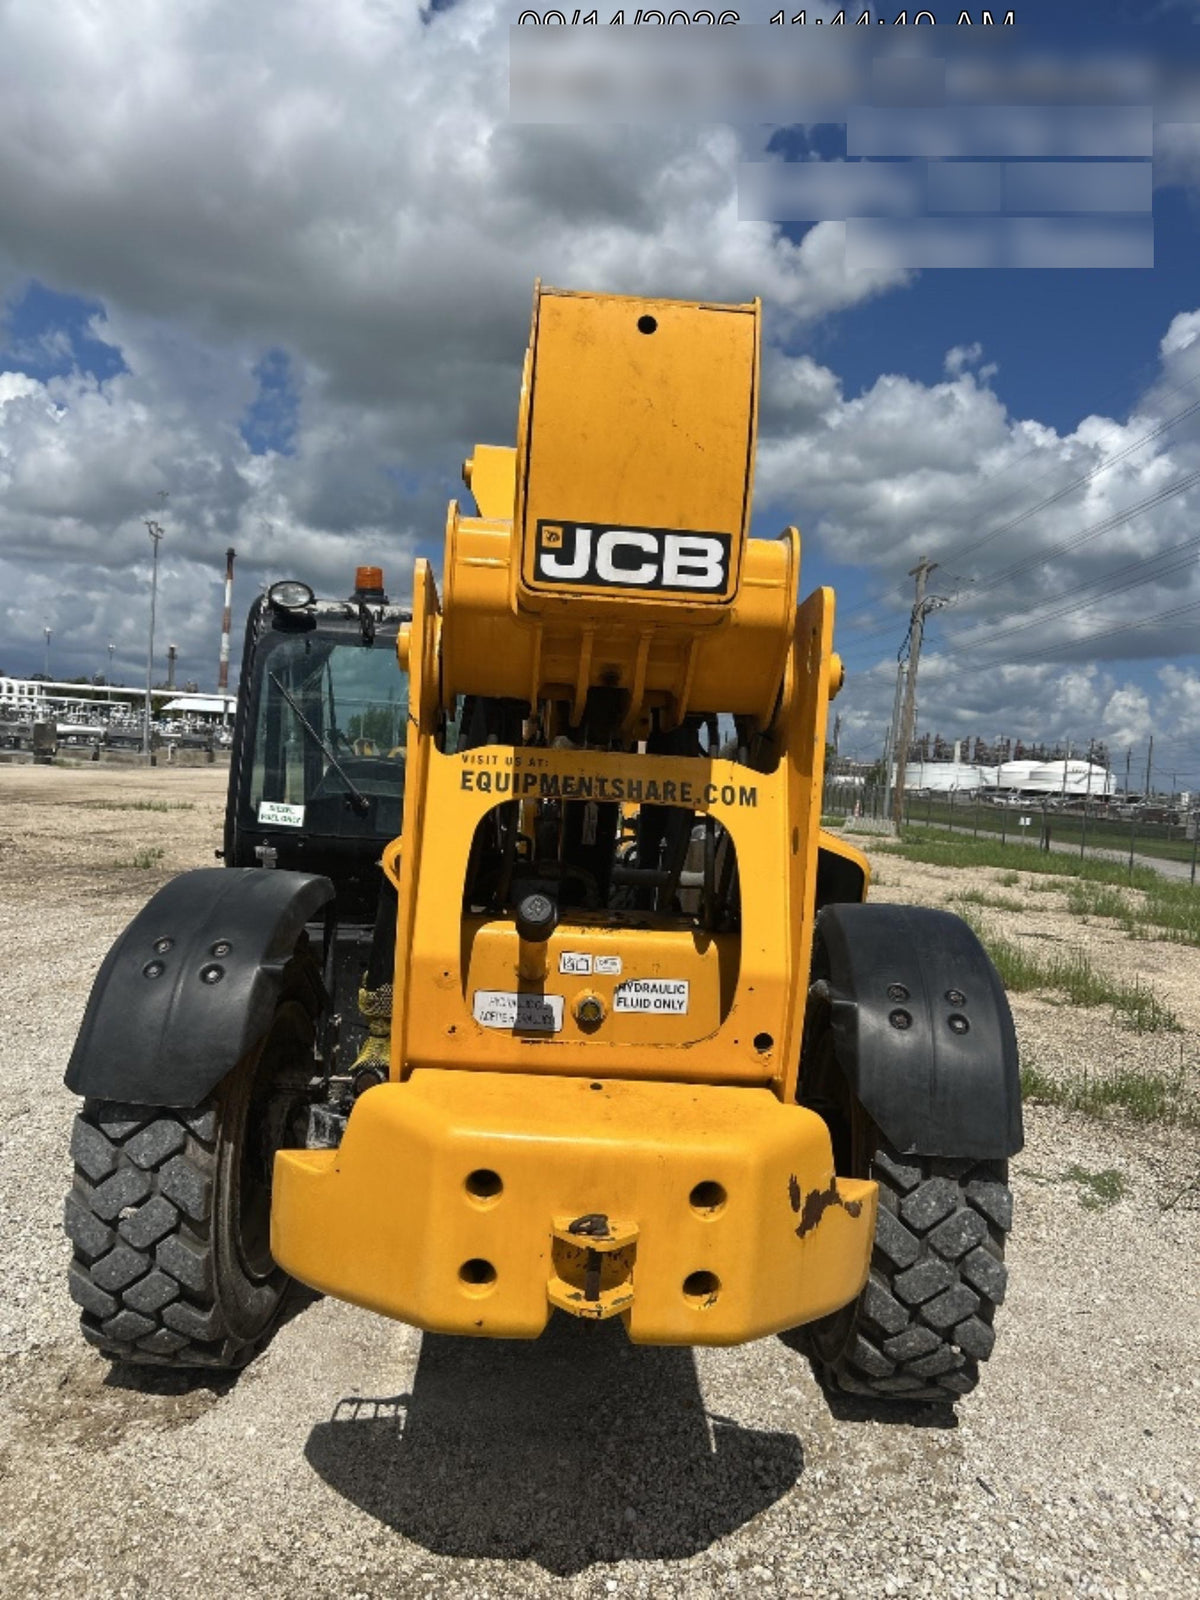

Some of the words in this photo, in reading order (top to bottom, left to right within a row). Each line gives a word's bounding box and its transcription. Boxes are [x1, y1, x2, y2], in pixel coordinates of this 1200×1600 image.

[540, 527, 724, 588] JCB
[461, 754, 498, 766] VISIT
[505, 757, 522, 767] US
[528, 757, 549, 767] AT:
[461, 770, 757, 807] EQUIPMENTSHARE.COM
[618, 982, 686, 995] HYDRAULIC
[616, 996, 651, 1009] FLUID
[654, 998, 684, 1010] ONLY
